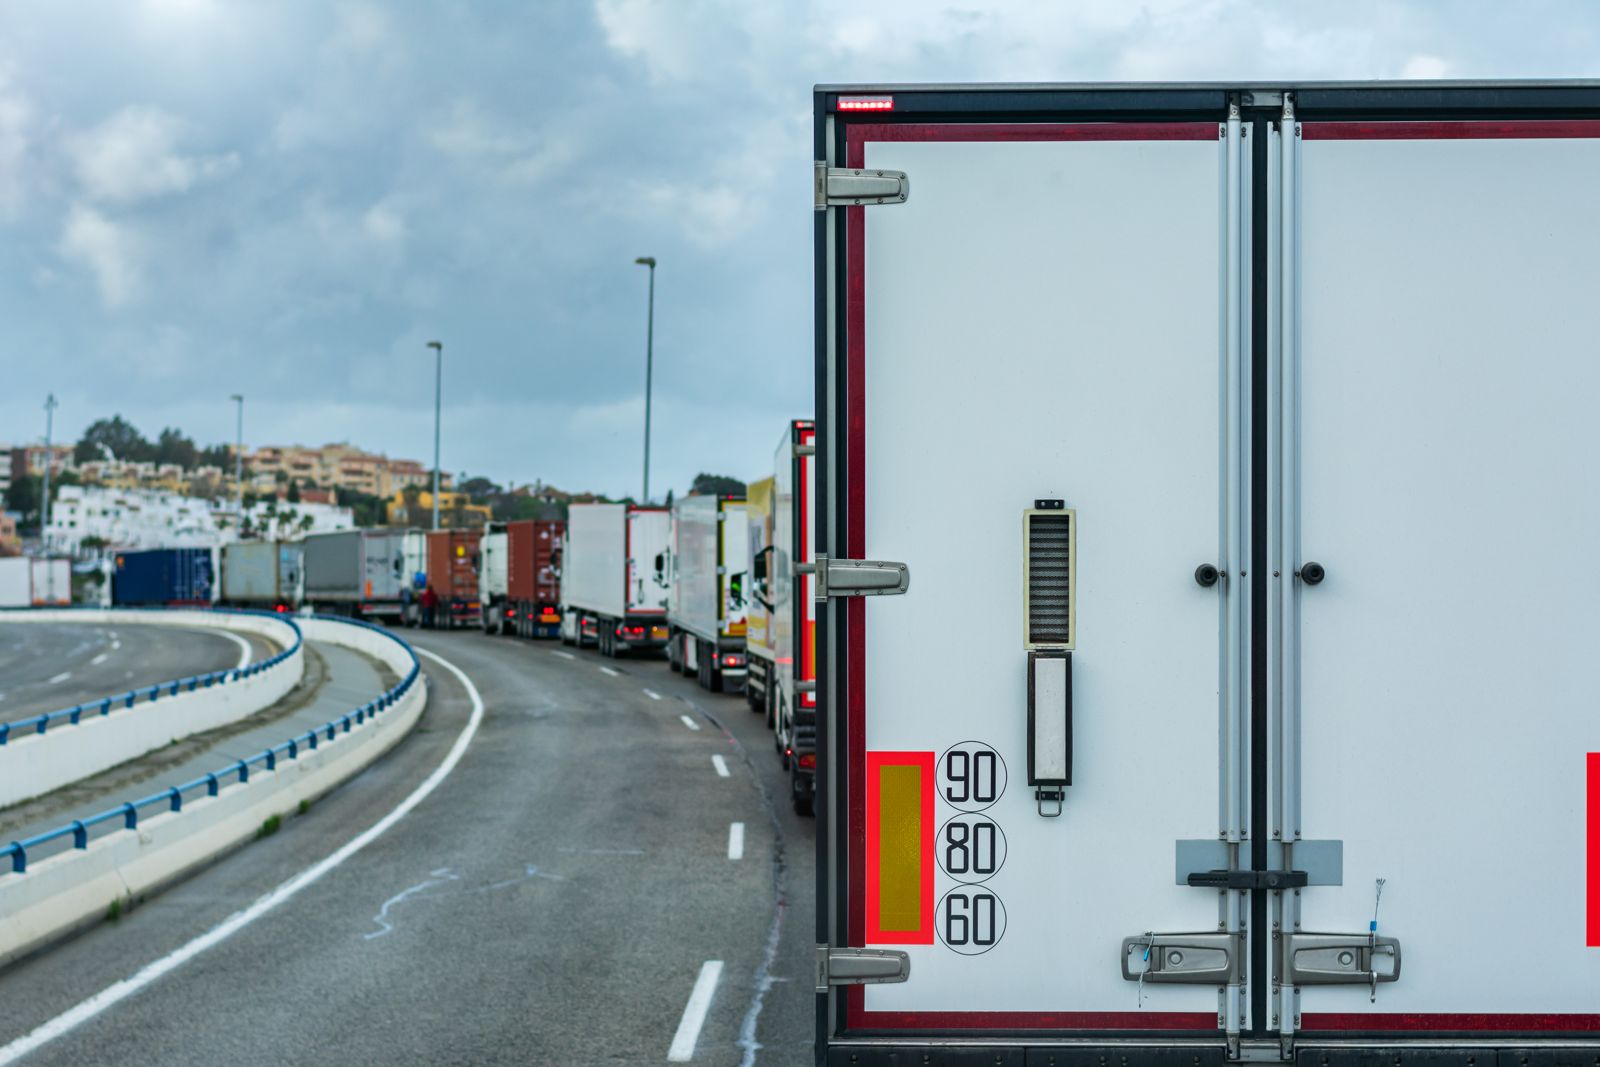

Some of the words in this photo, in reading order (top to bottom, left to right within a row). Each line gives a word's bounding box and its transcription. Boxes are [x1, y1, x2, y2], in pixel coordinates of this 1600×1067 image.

[947, 751, 996, 802] 90
[946, 823, 995, 874] 80
[946, 894, 995, 945] 60
